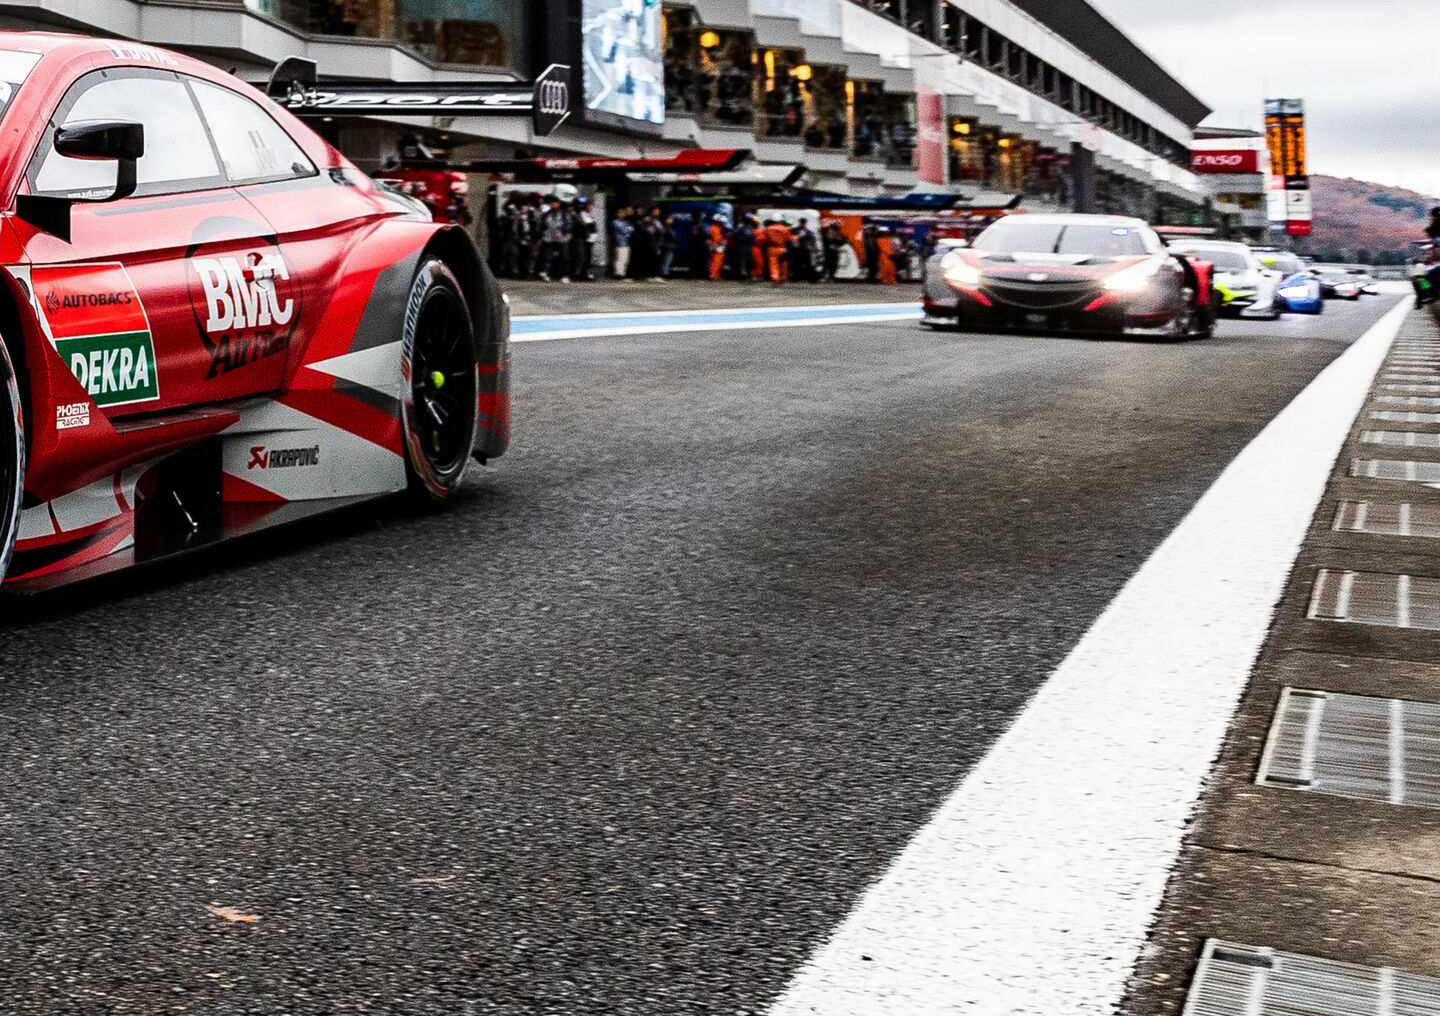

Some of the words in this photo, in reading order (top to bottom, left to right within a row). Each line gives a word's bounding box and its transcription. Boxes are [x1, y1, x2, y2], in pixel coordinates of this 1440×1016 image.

[1192, 154, 1243, 166] ENSO
[62, 291, 132, 309] AUTOBACS
[192, 254, 294, 332] BMC
[71, 345, 150, 396] DEKRA
[56, 402, 90, 418] PHOENIX
